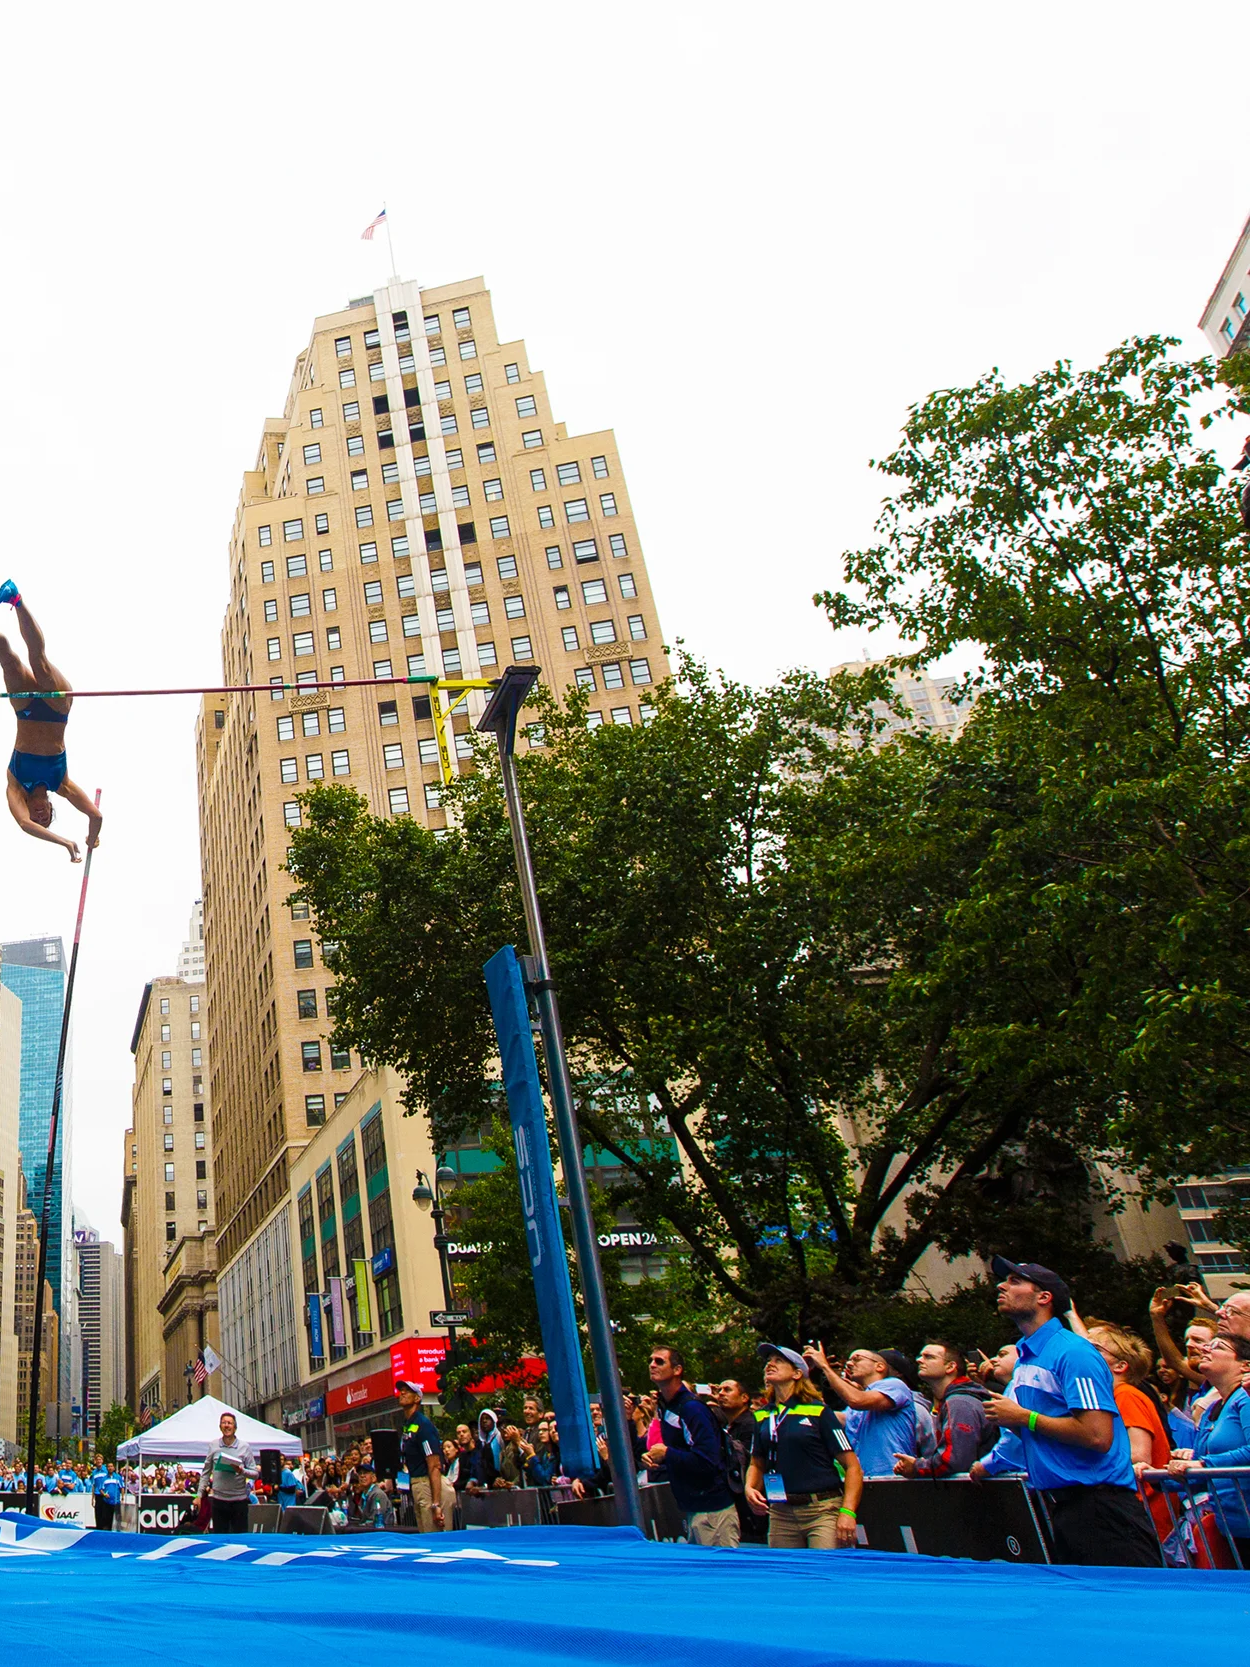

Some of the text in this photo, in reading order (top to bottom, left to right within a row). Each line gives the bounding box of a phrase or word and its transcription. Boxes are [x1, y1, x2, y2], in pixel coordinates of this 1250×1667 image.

[432, 696, 442, 719] UCS
[441, 745, 450, 769] UCS
[514, 1125, 542, 1267] UCS
[598, 1233, 642, 1247] OPEN
[57, 1511, 80, 1519] IAAF
